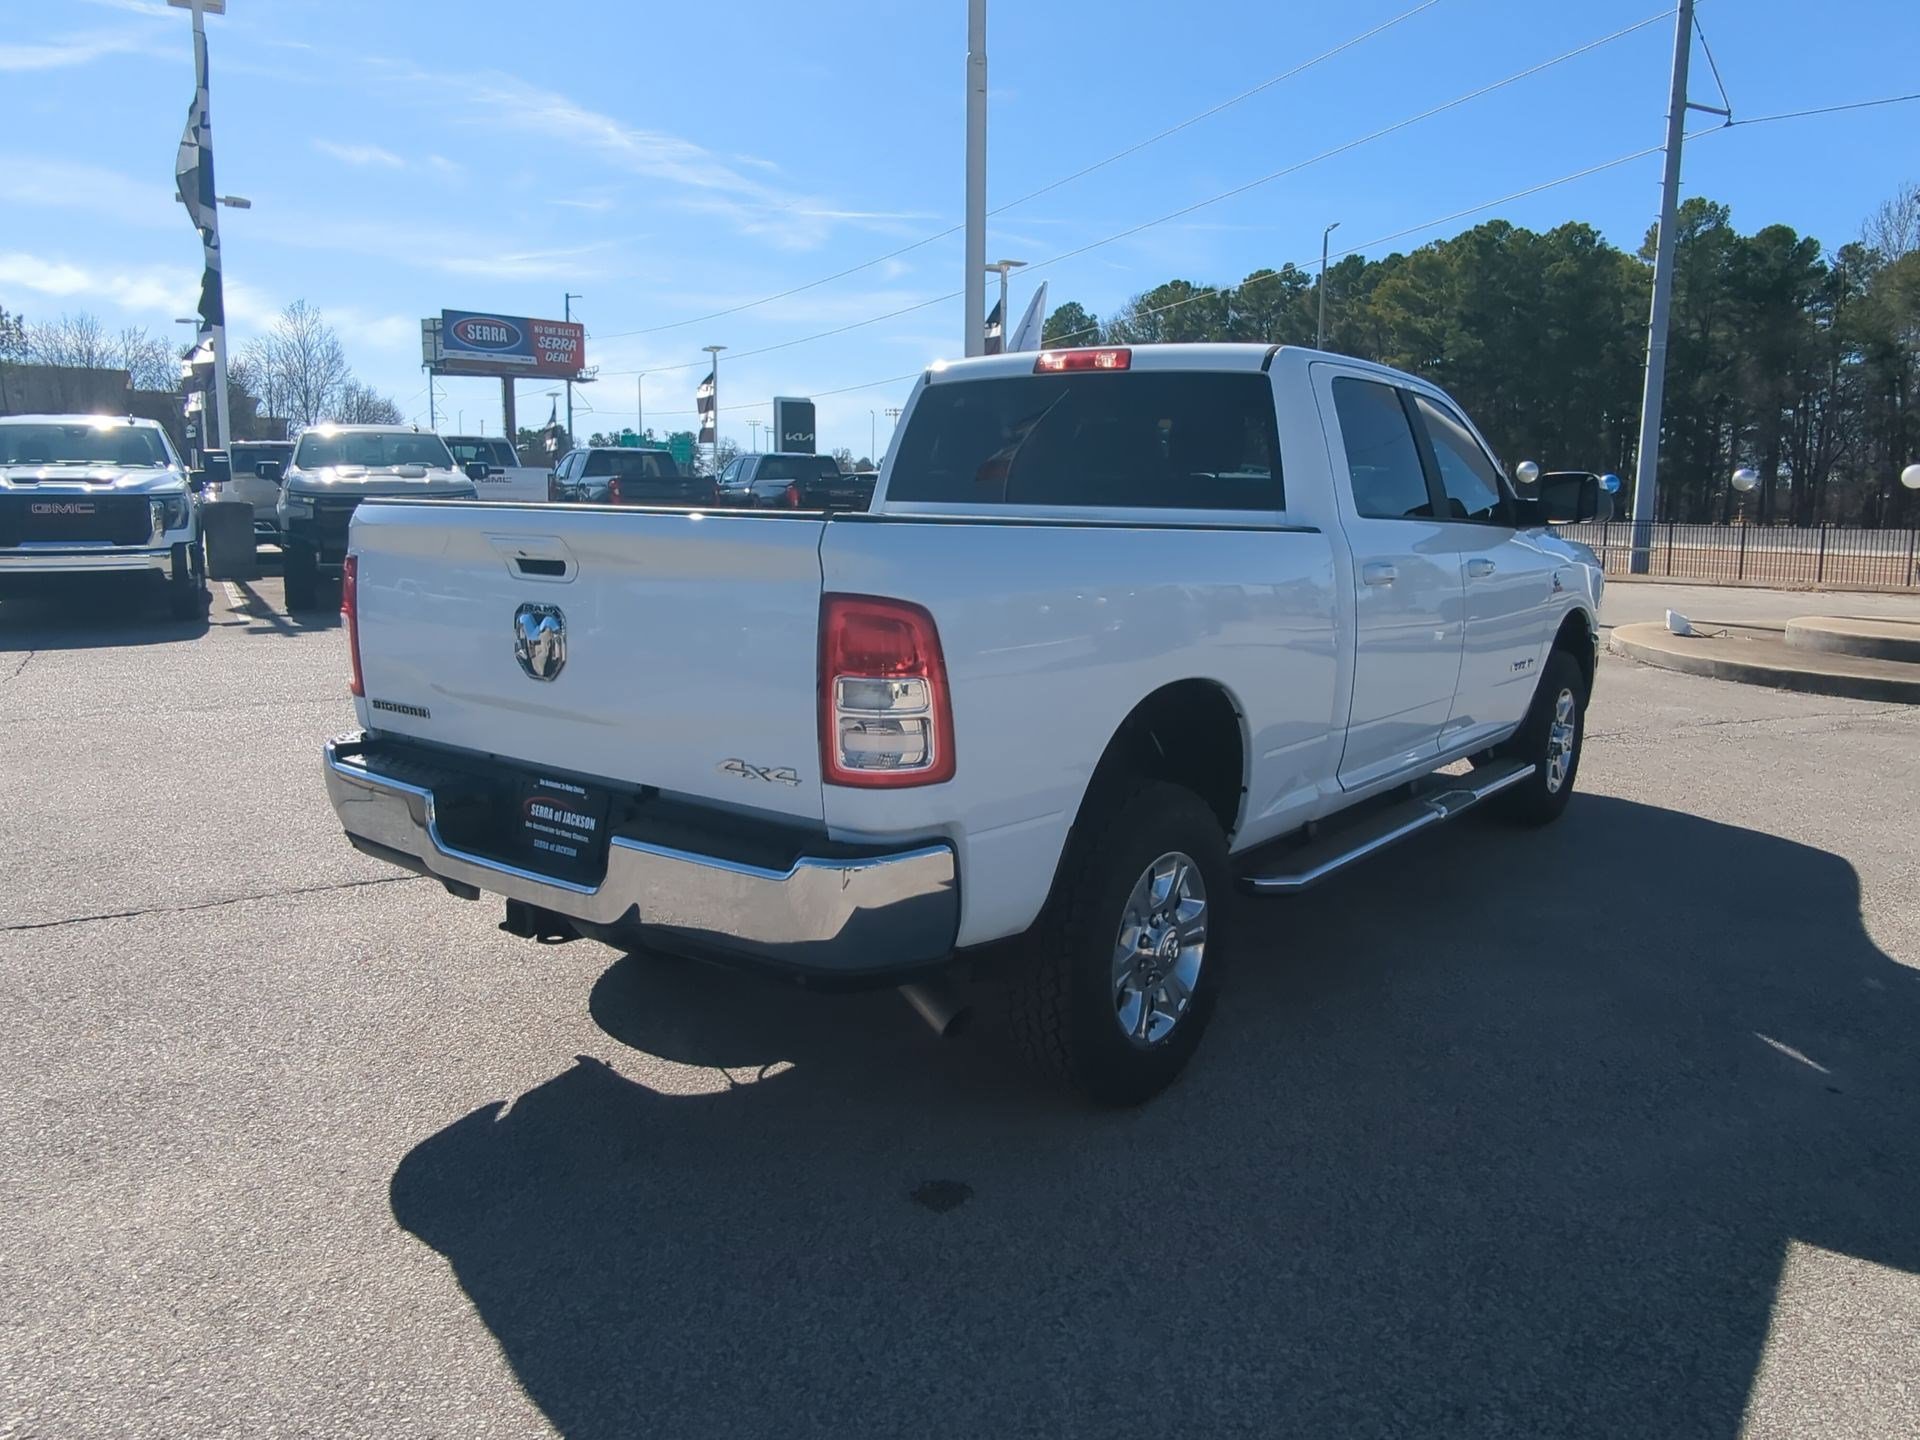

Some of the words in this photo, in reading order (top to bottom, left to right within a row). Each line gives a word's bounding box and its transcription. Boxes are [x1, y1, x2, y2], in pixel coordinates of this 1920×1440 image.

[467, 324, 508, 343] SERRA
[538, 336, 577, 352] SERRA
[545, 351, 573, 363] DEAL!
[31, 503, 96, 514] GMC
[531, 804, 554, 821] SERRA
[554, 810, 562, 822] of
[562, 812, 596, 831] JACKSON
